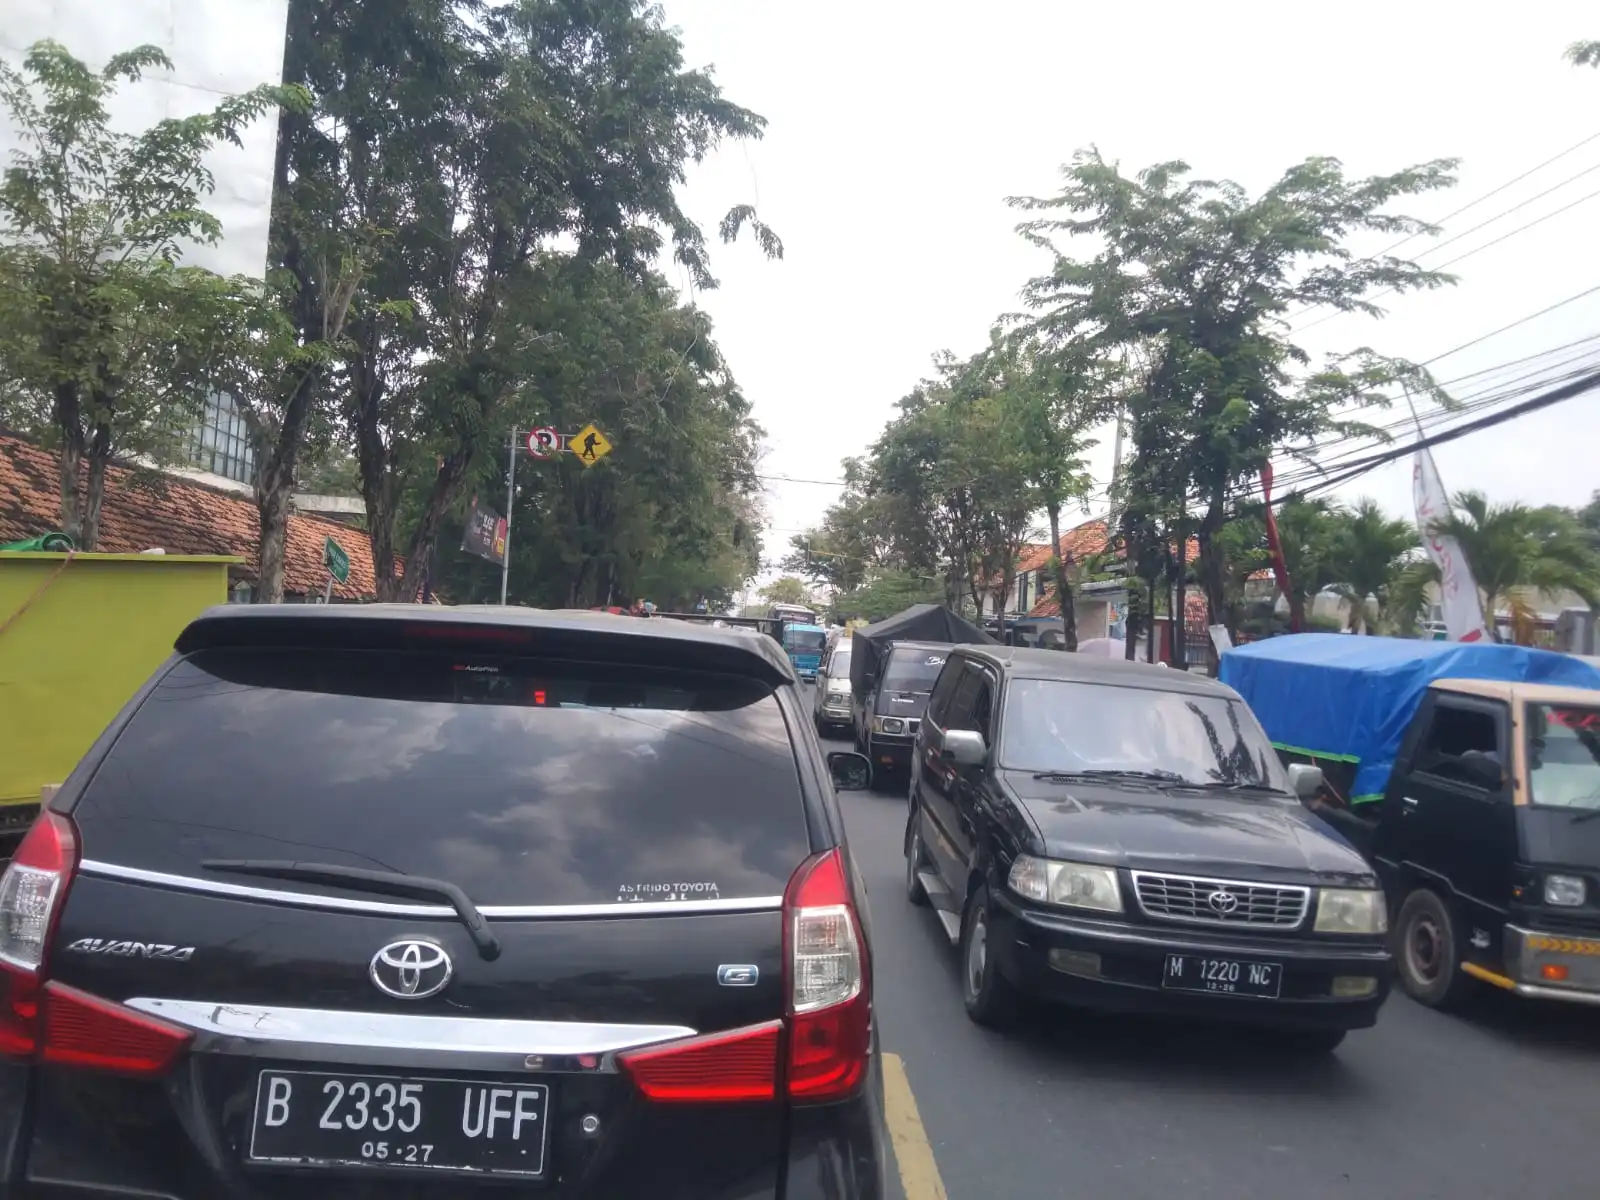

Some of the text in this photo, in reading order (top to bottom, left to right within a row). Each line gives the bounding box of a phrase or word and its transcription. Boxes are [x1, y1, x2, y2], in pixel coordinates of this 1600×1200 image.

[673, 882, 719, 892] TOYOTA
[66, 938, 196, 961] AVANZA
[1170, 957, 1272, 985] M 1220 NC
[265, 1077, 539, 1140] B 2335 UFF
